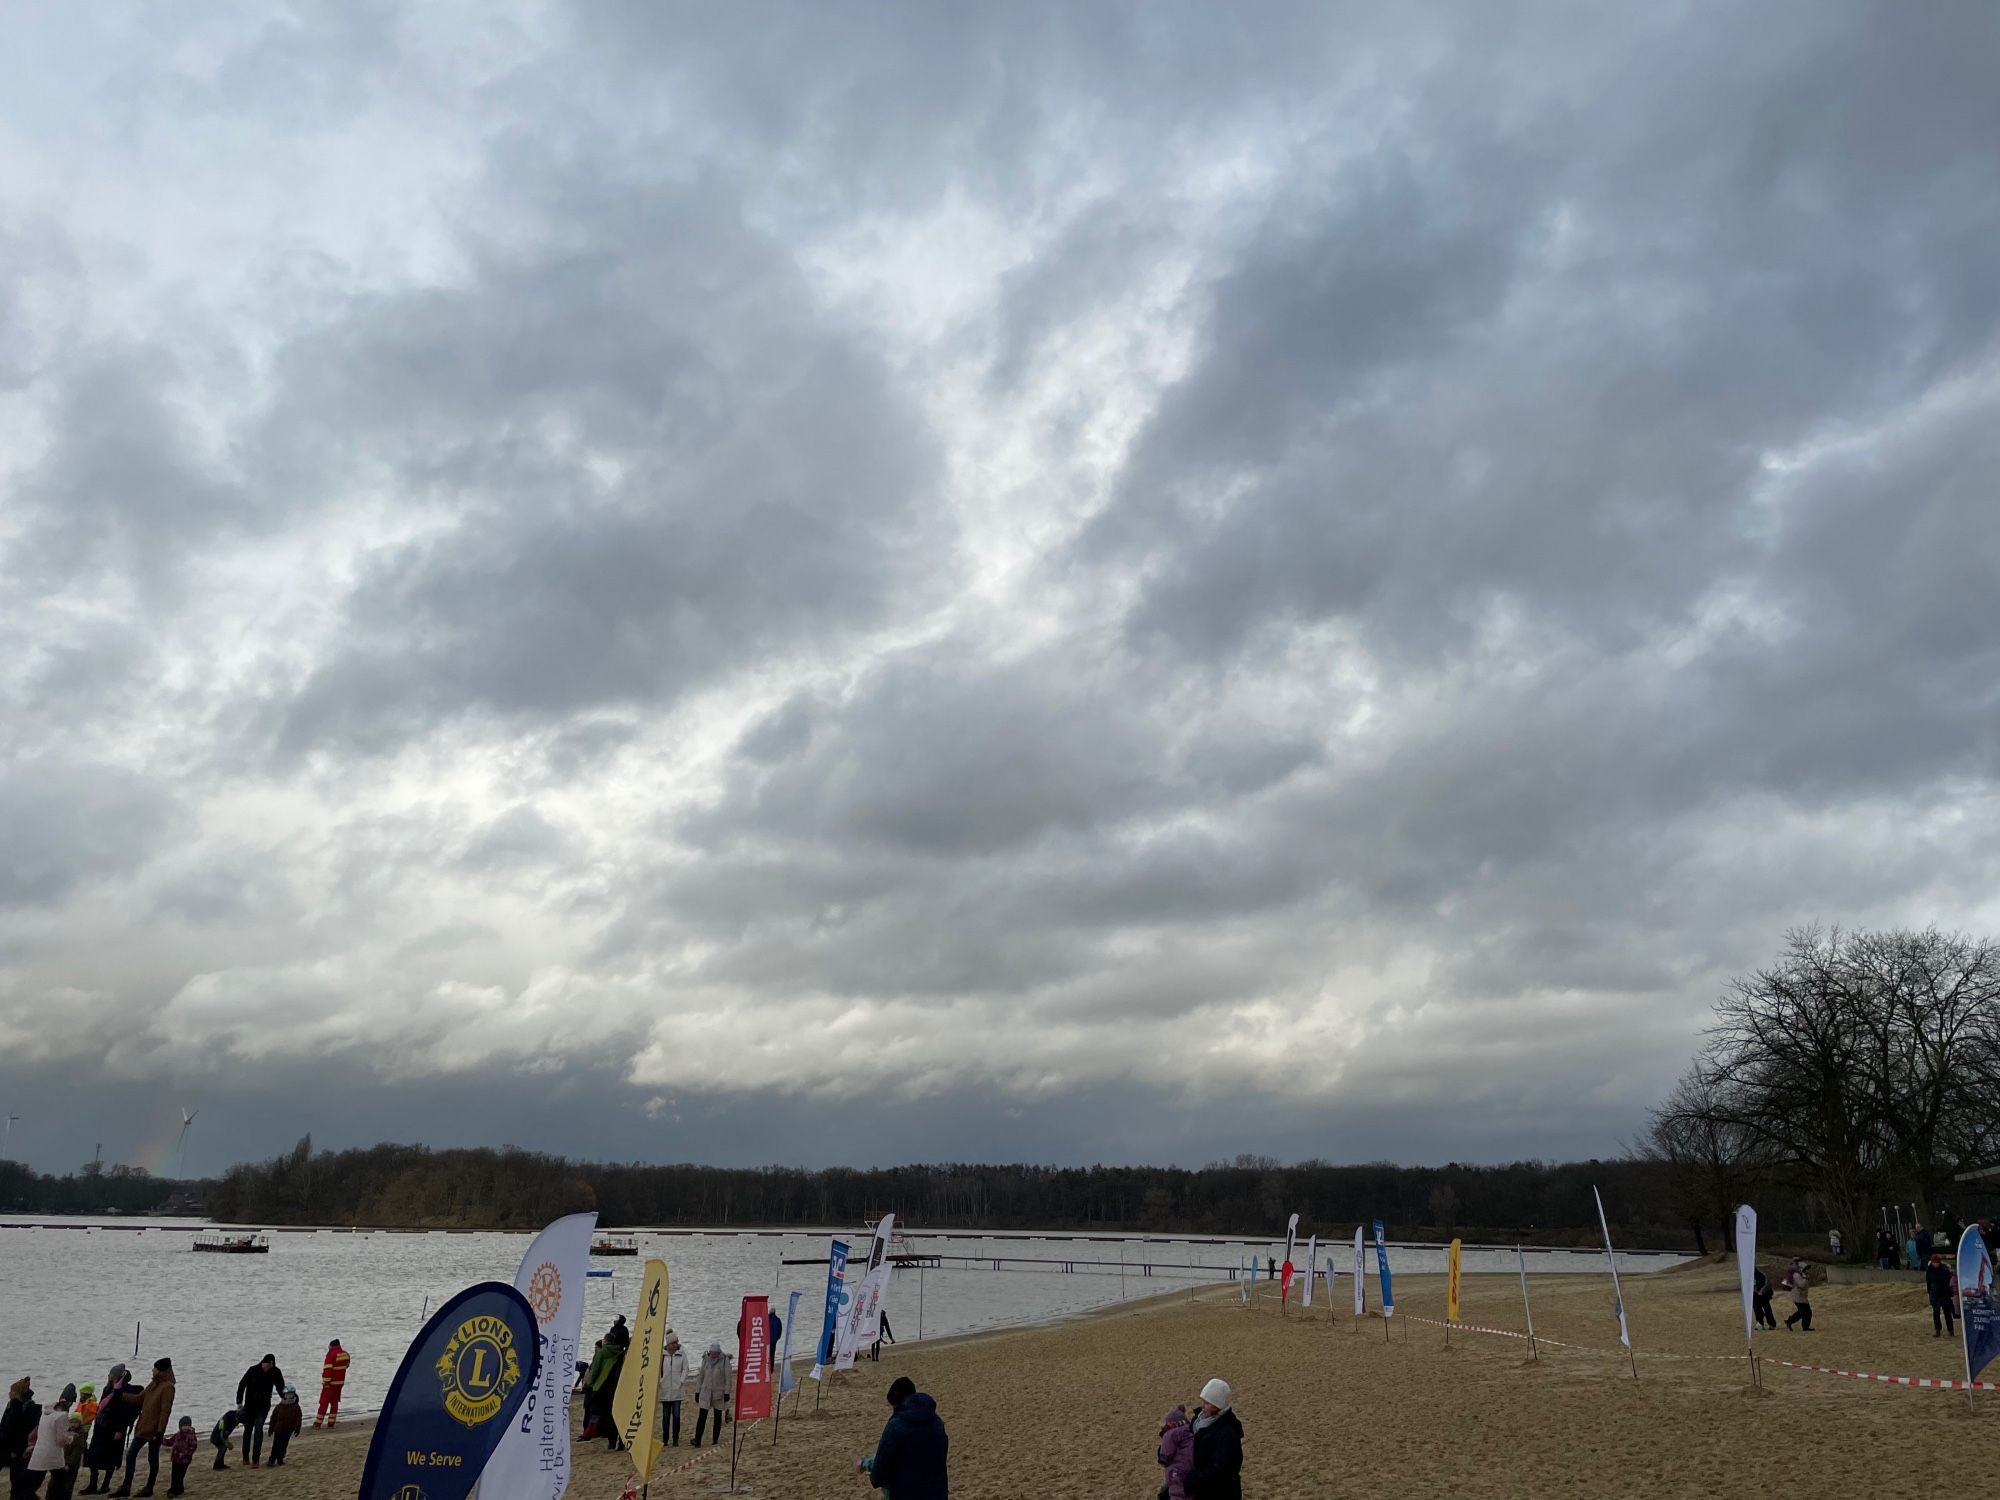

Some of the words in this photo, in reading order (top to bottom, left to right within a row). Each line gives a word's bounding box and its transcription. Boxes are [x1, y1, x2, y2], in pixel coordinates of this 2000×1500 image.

[461, 1318, 511, 1345] LIONS
[562, 1337, 574, 1378] was!
[743, 1316, 765, 1385] Philipps
[468, 1348, 490, 1387] L
[544, 1371, 555, 1399] am
[450, 1396, 498, 1418] INTERNATIONAL
[539, 1405, 555, 1472] Haltern
[407, 1450, 426, 1466] We
[429, 1451, 462, 1467] Serve
